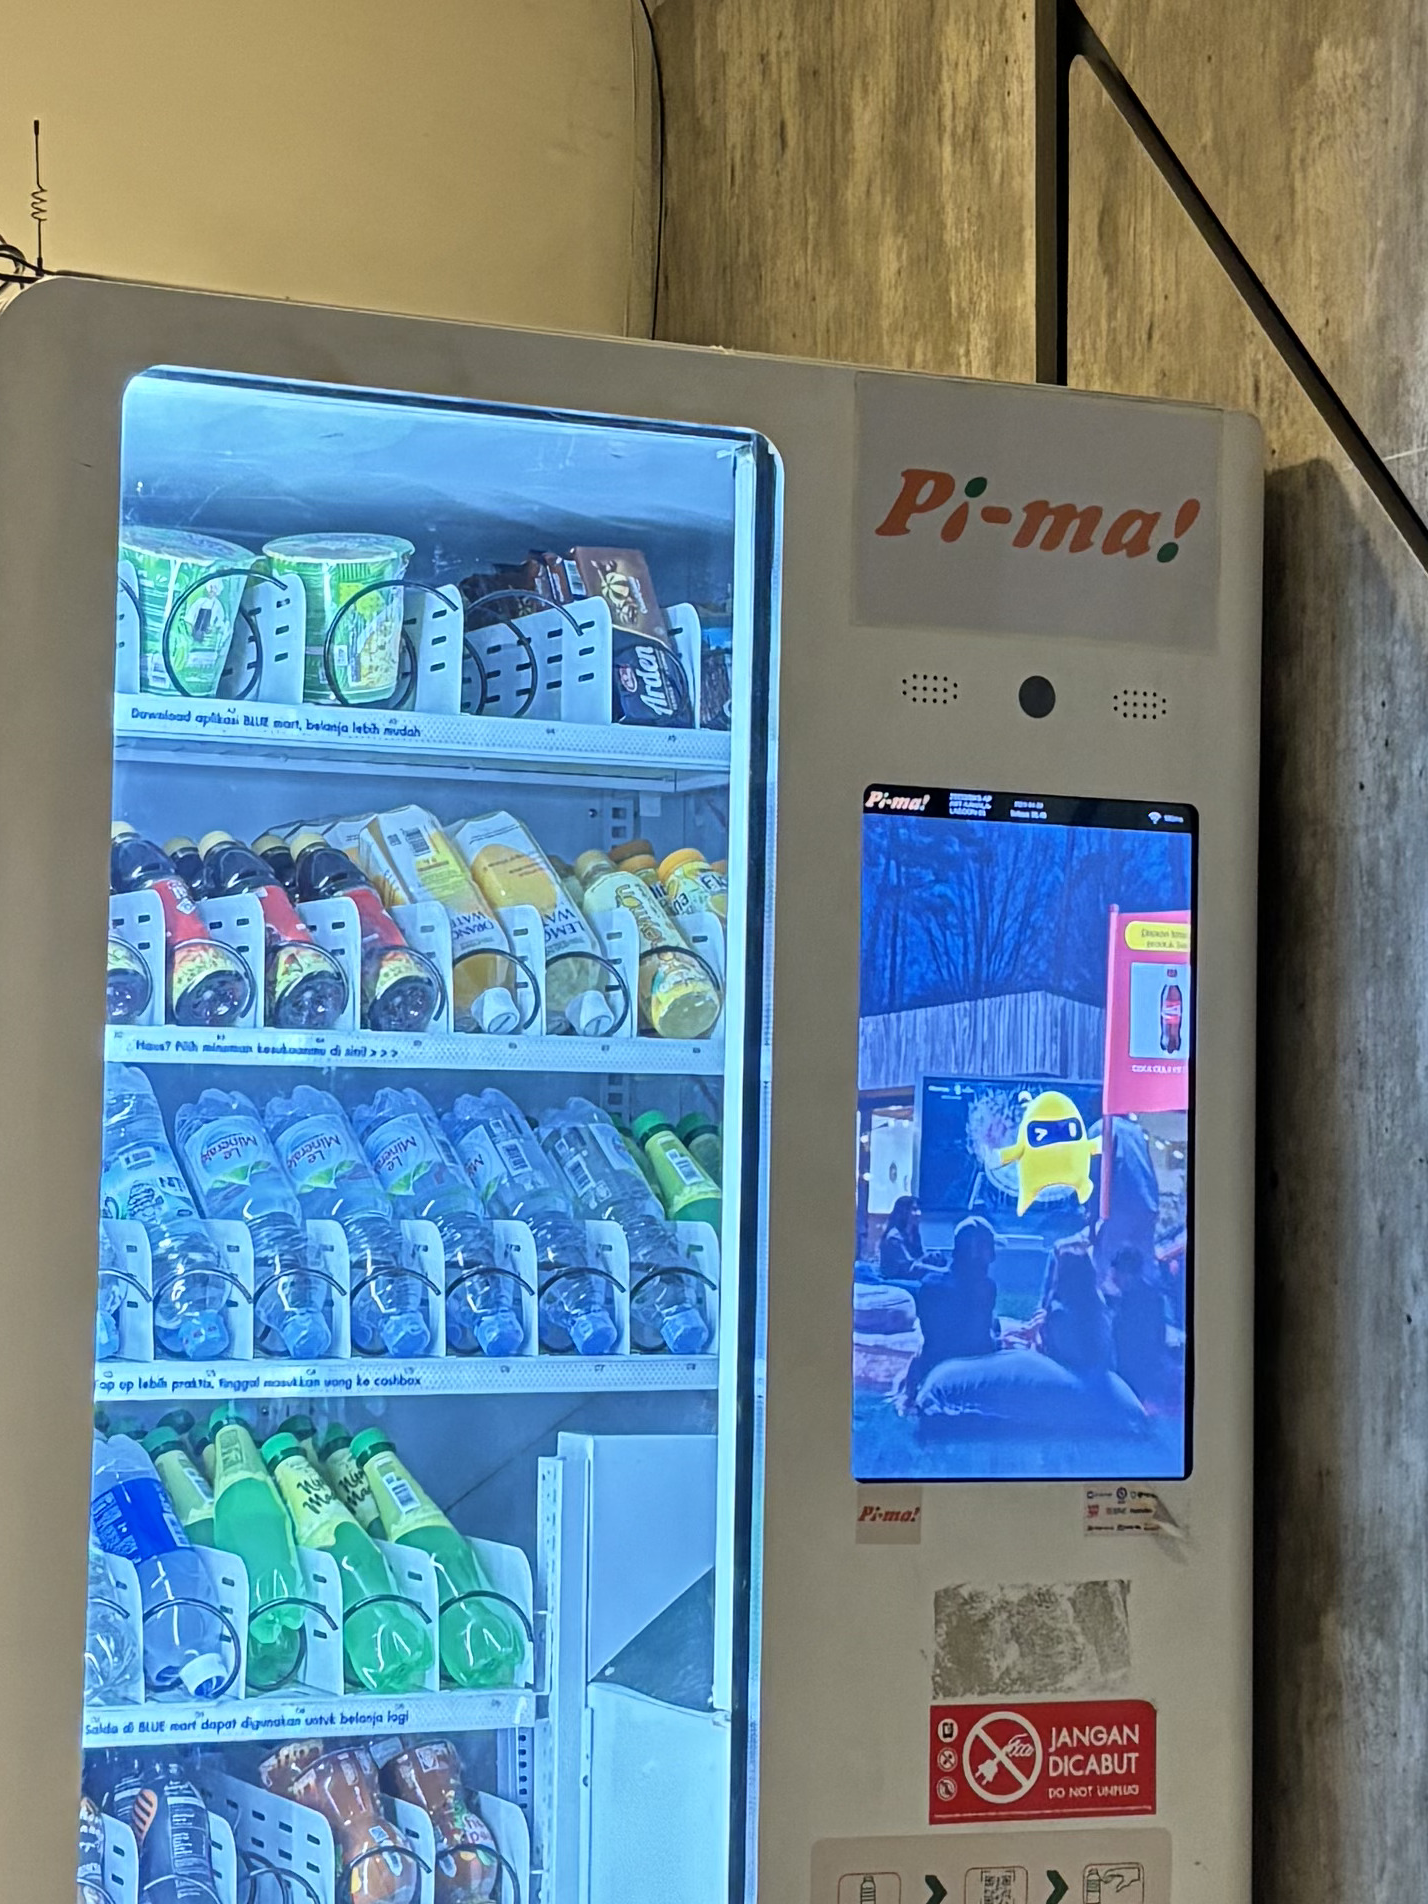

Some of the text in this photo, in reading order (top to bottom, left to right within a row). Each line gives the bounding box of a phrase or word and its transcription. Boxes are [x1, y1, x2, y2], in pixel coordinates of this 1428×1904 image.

[874, 468, 1201, 564] Pi-ma!
[635, 645, 673, 716] Arden
[131, 707, 191, 722] Download
[865, 790, 930, 811] Pi-ma!
[330, 1044, 341, 1056] di
[374, 1373, 421, 1387] cashbox
[138, 1720, 165, 1733] BLUE
[201, 1717, 237, 1734] dapat
[240, 1714, 301, 1732] digunakan
[340, 1710, 383, 1727] belanja
[387, 1709, 409, 1725] lagi
[1048, 1724, 1139, 1753] JANGAN
[1049, 1752, 1139, 1777] DICABUT
[1048, 1784, 1139, 1799] DO NOT UNPLUG
